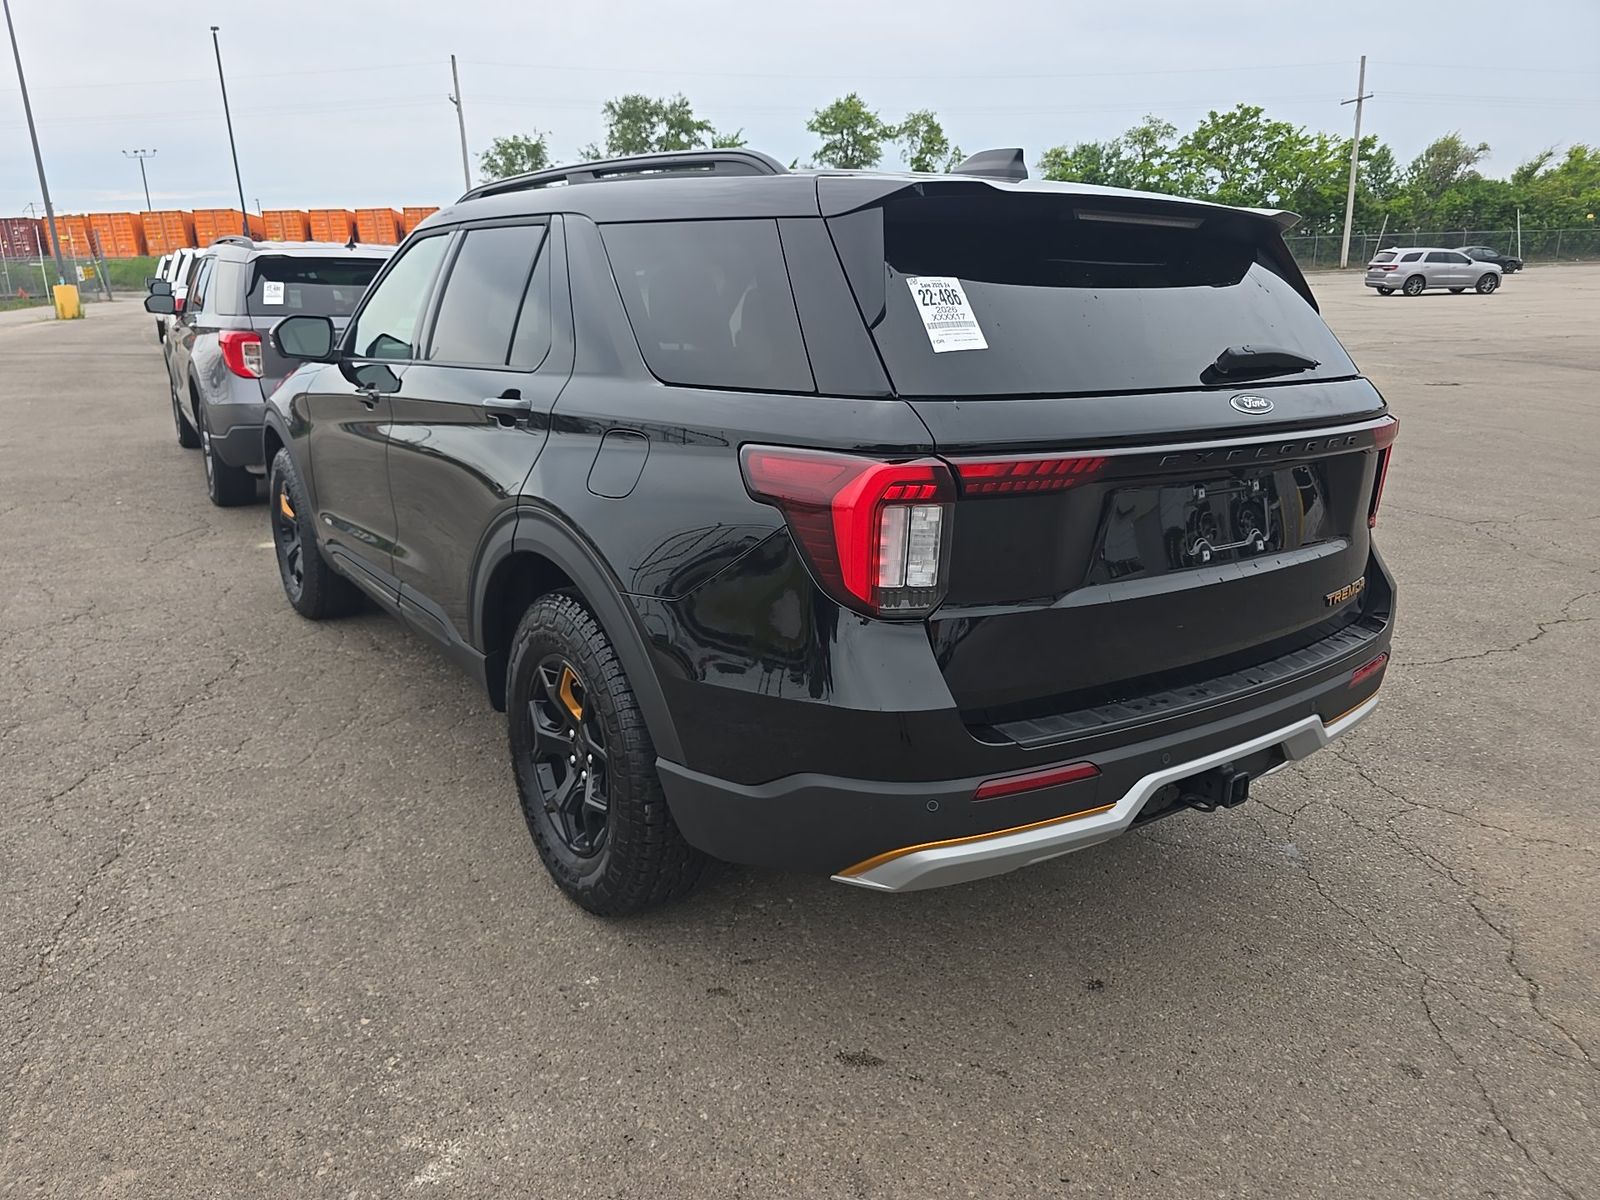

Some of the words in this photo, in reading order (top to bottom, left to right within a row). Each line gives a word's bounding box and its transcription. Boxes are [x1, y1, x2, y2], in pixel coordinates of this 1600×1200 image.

[918, 289, 962, 306] 22:486
[1242, 396, 1268, 408] Ford
[1325, 576, 1366, 606] TREMOR
